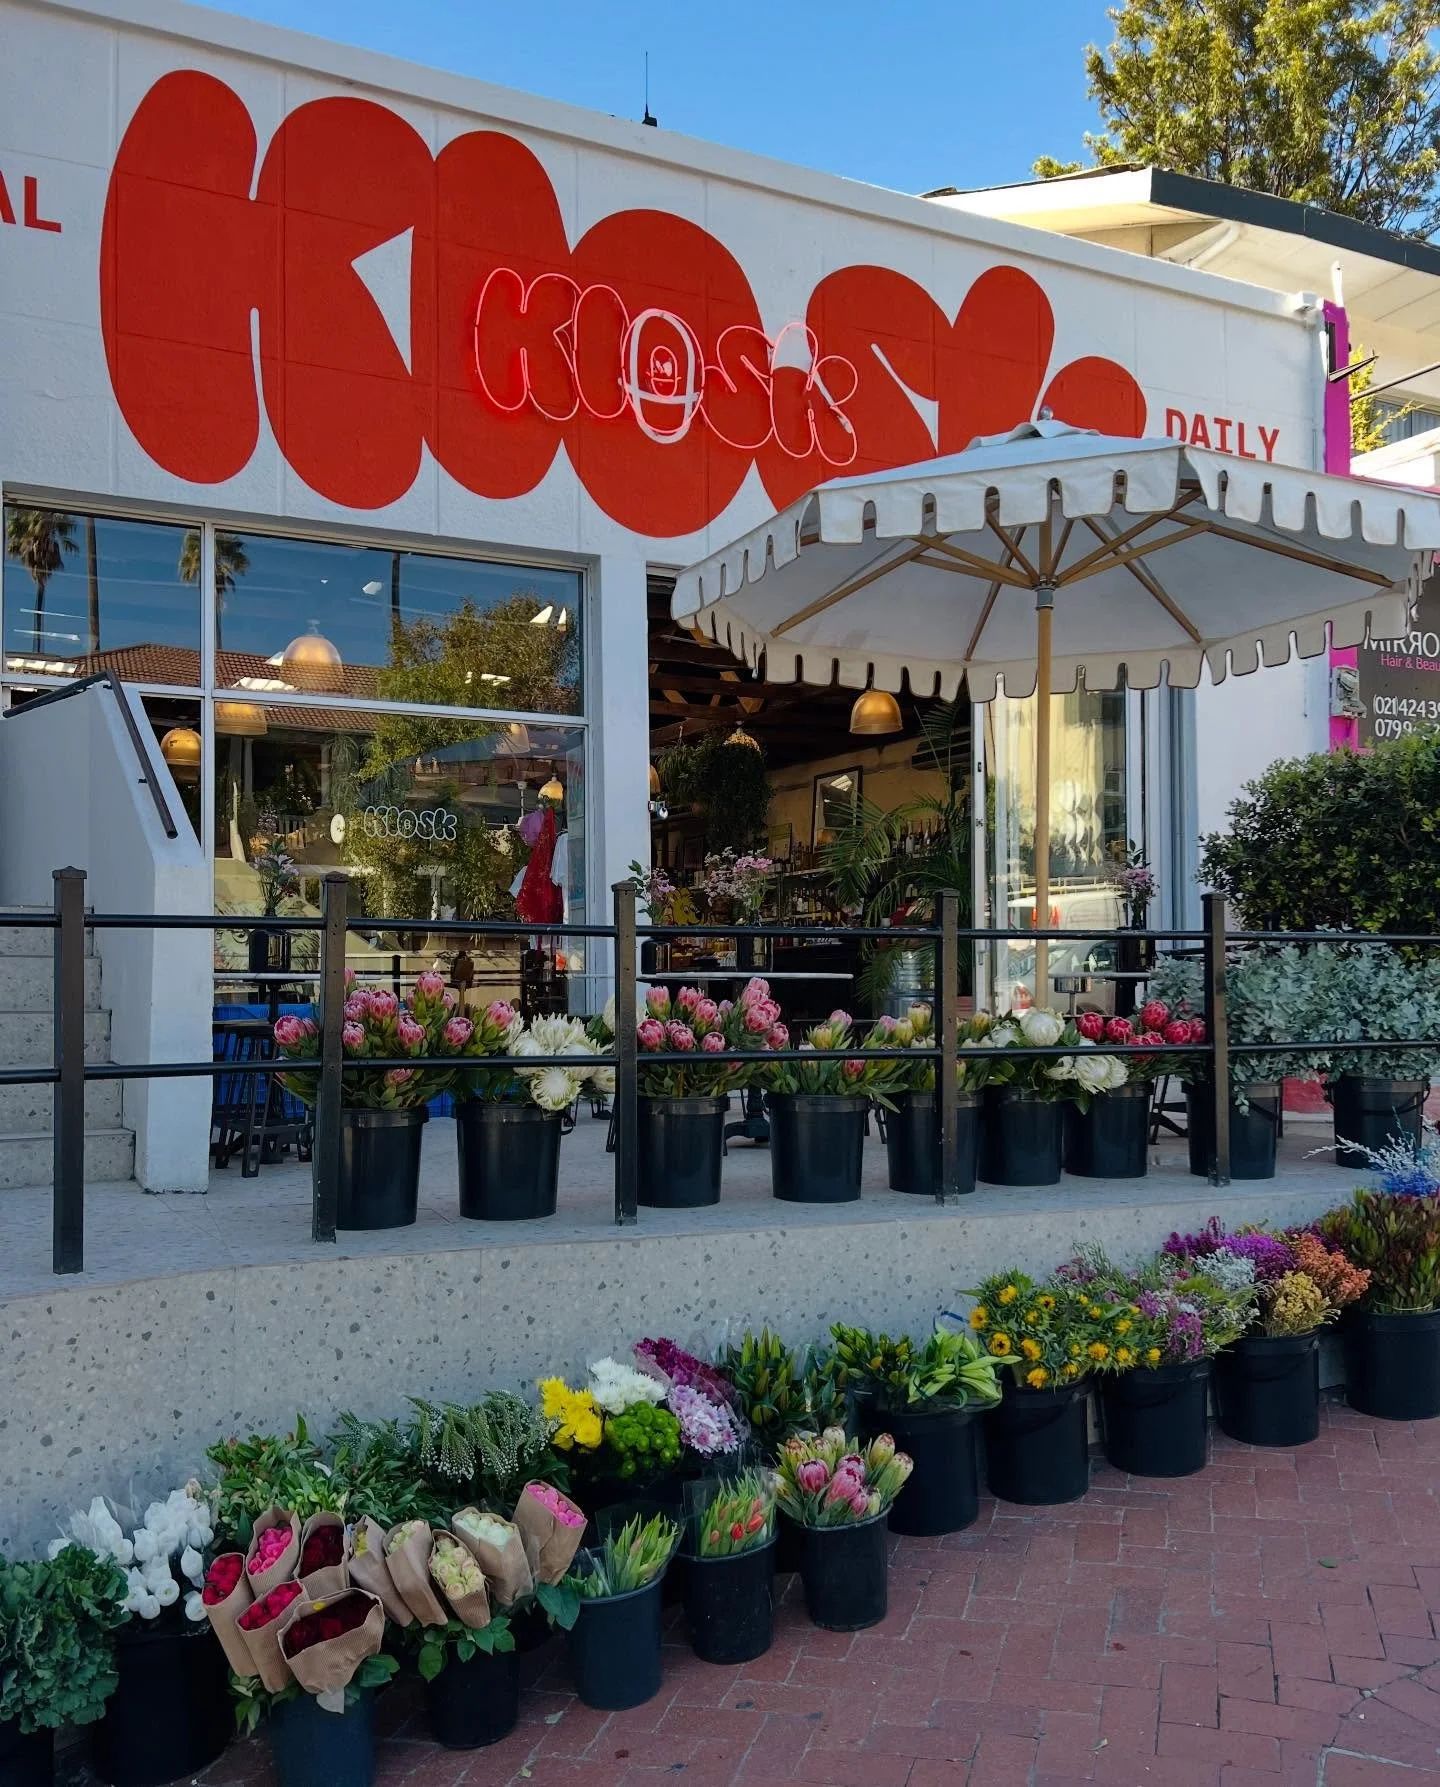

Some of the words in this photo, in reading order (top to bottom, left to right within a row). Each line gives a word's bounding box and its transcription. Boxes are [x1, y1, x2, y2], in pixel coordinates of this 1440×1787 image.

[1166, 407, 1280, 463] DAILY
[1381, 653, 1402, 668] Hair
[1405, 656, 1414, 669] &
